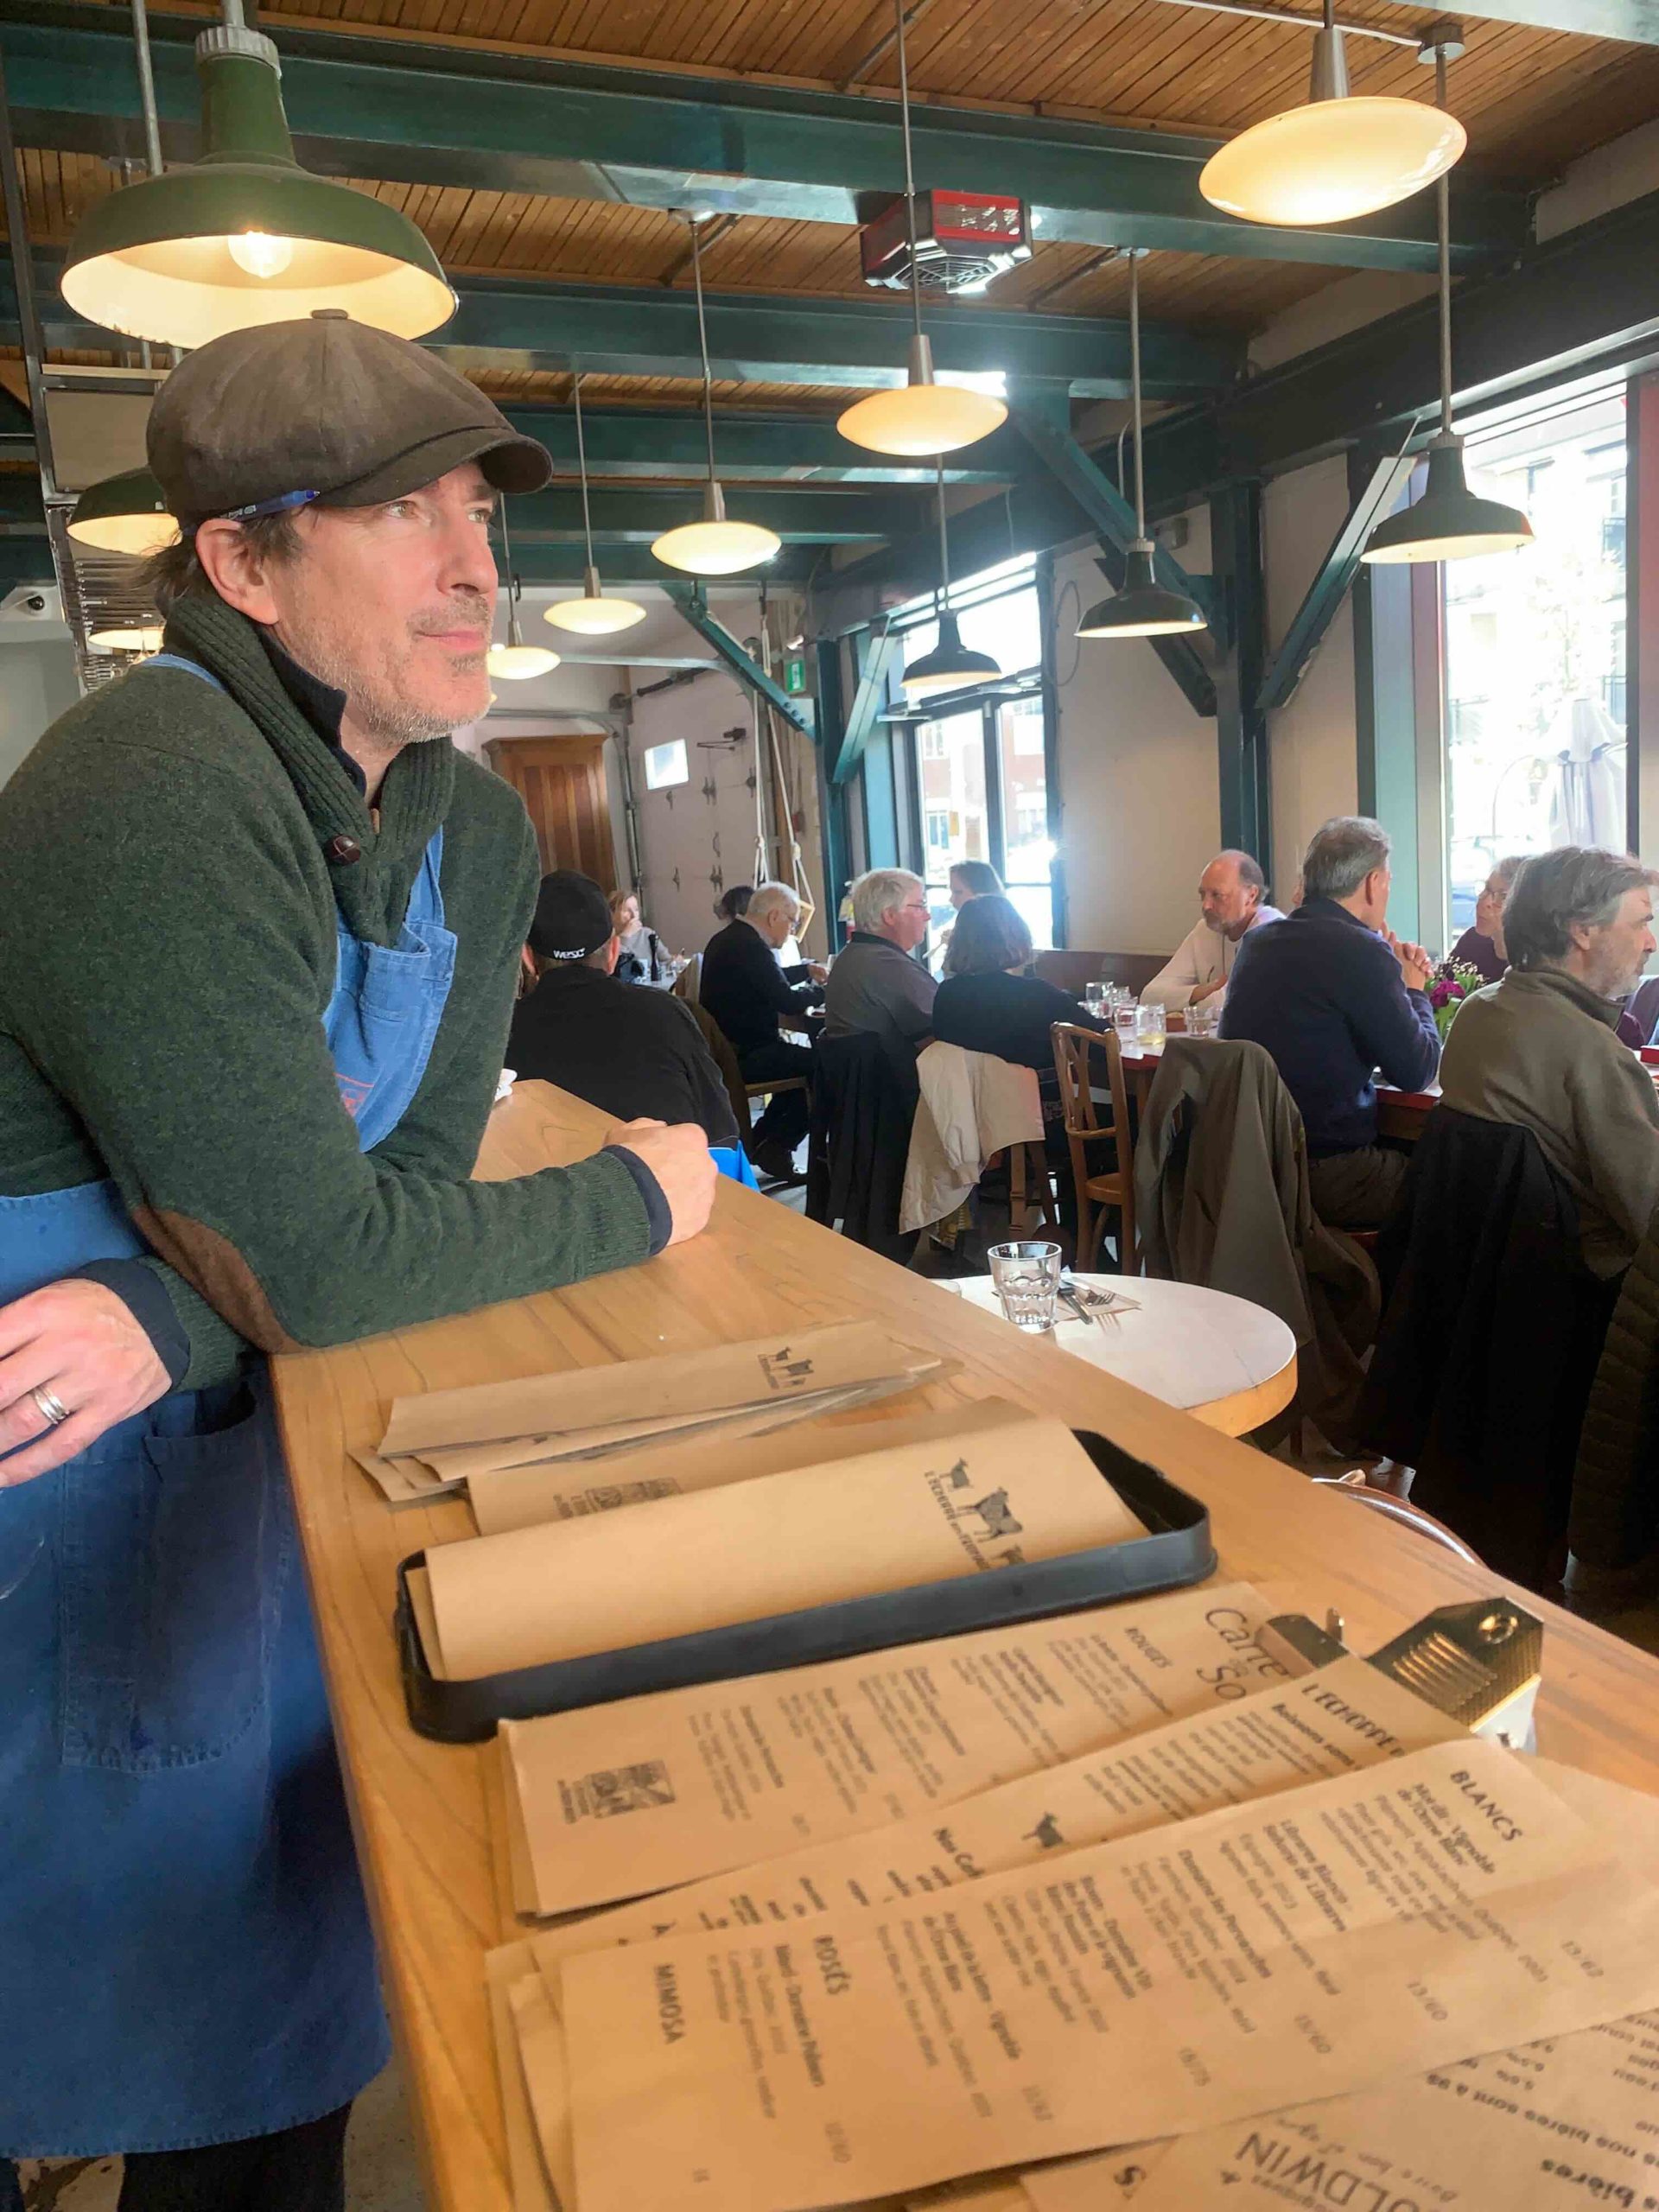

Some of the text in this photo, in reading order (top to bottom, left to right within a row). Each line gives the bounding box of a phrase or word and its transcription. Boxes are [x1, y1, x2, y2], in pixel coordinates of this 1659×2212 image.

[1124, 1626, 1173, 1669] ROUGES
[1205, 1607, 1289, 1679] Carte
[1451, 1770, 1522, 1840] BLANCS
[814, 1936, 851, 1994] ROSÉS
[654, 1964, 684, 2044] MIMOSA
[1473, 2091, 1518, 2113] sont
[1524, 2110, 1590, 2143] bières
[1596, 2137, 1636, 2158] nos
[1541, 2158, 1635, 2209] bières
